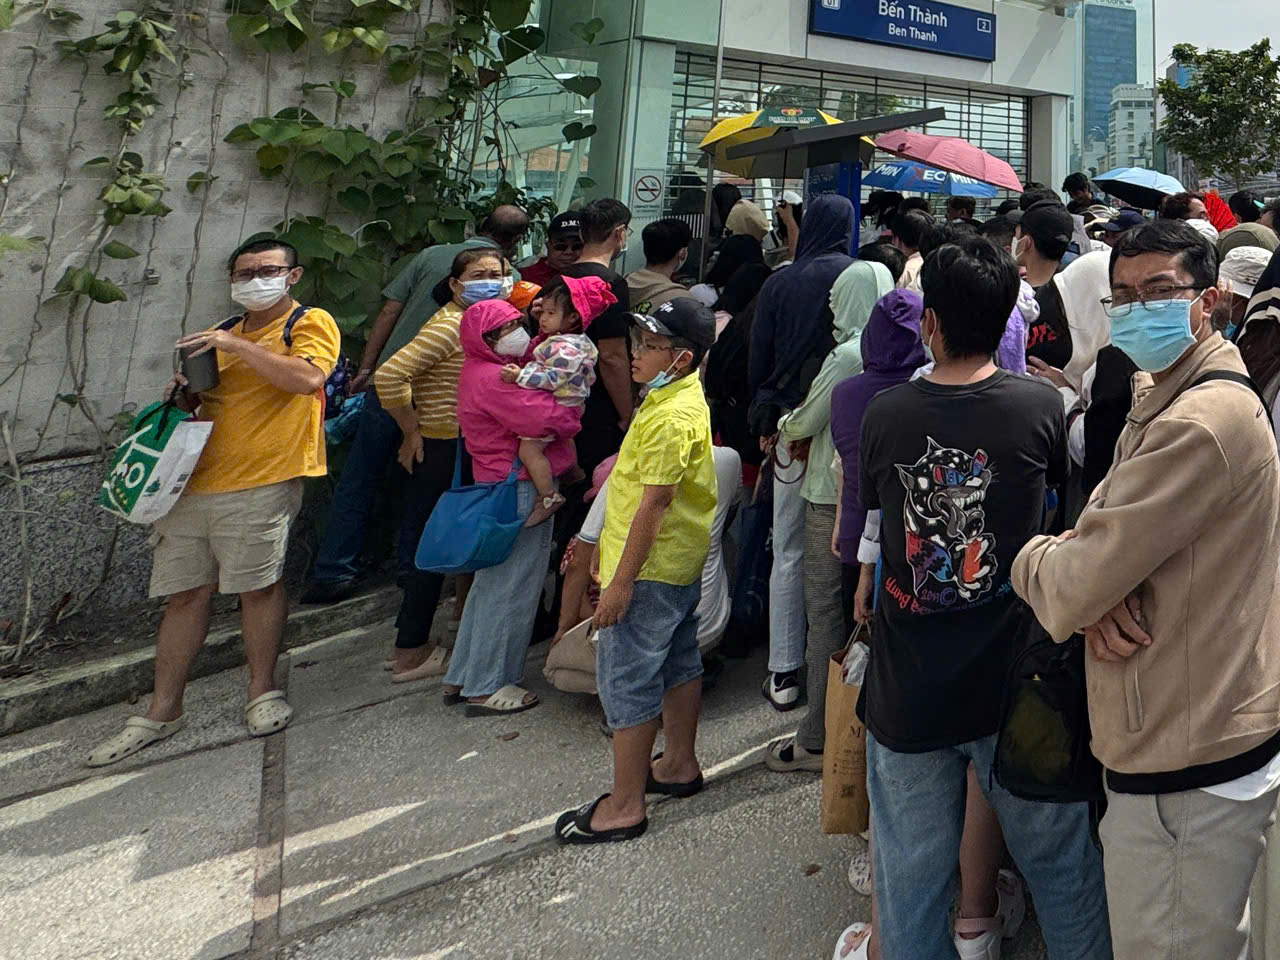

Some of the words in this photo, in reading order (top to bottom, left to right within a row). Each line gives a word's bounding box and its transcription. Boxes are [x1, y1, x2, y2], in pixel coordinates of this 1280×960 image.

[908, 4, 948, 27] Thành
[888, 23, 907, 37] Ben
[909, 26, 938, 43] Thanh
[875, 163, 903, 177] MIN
